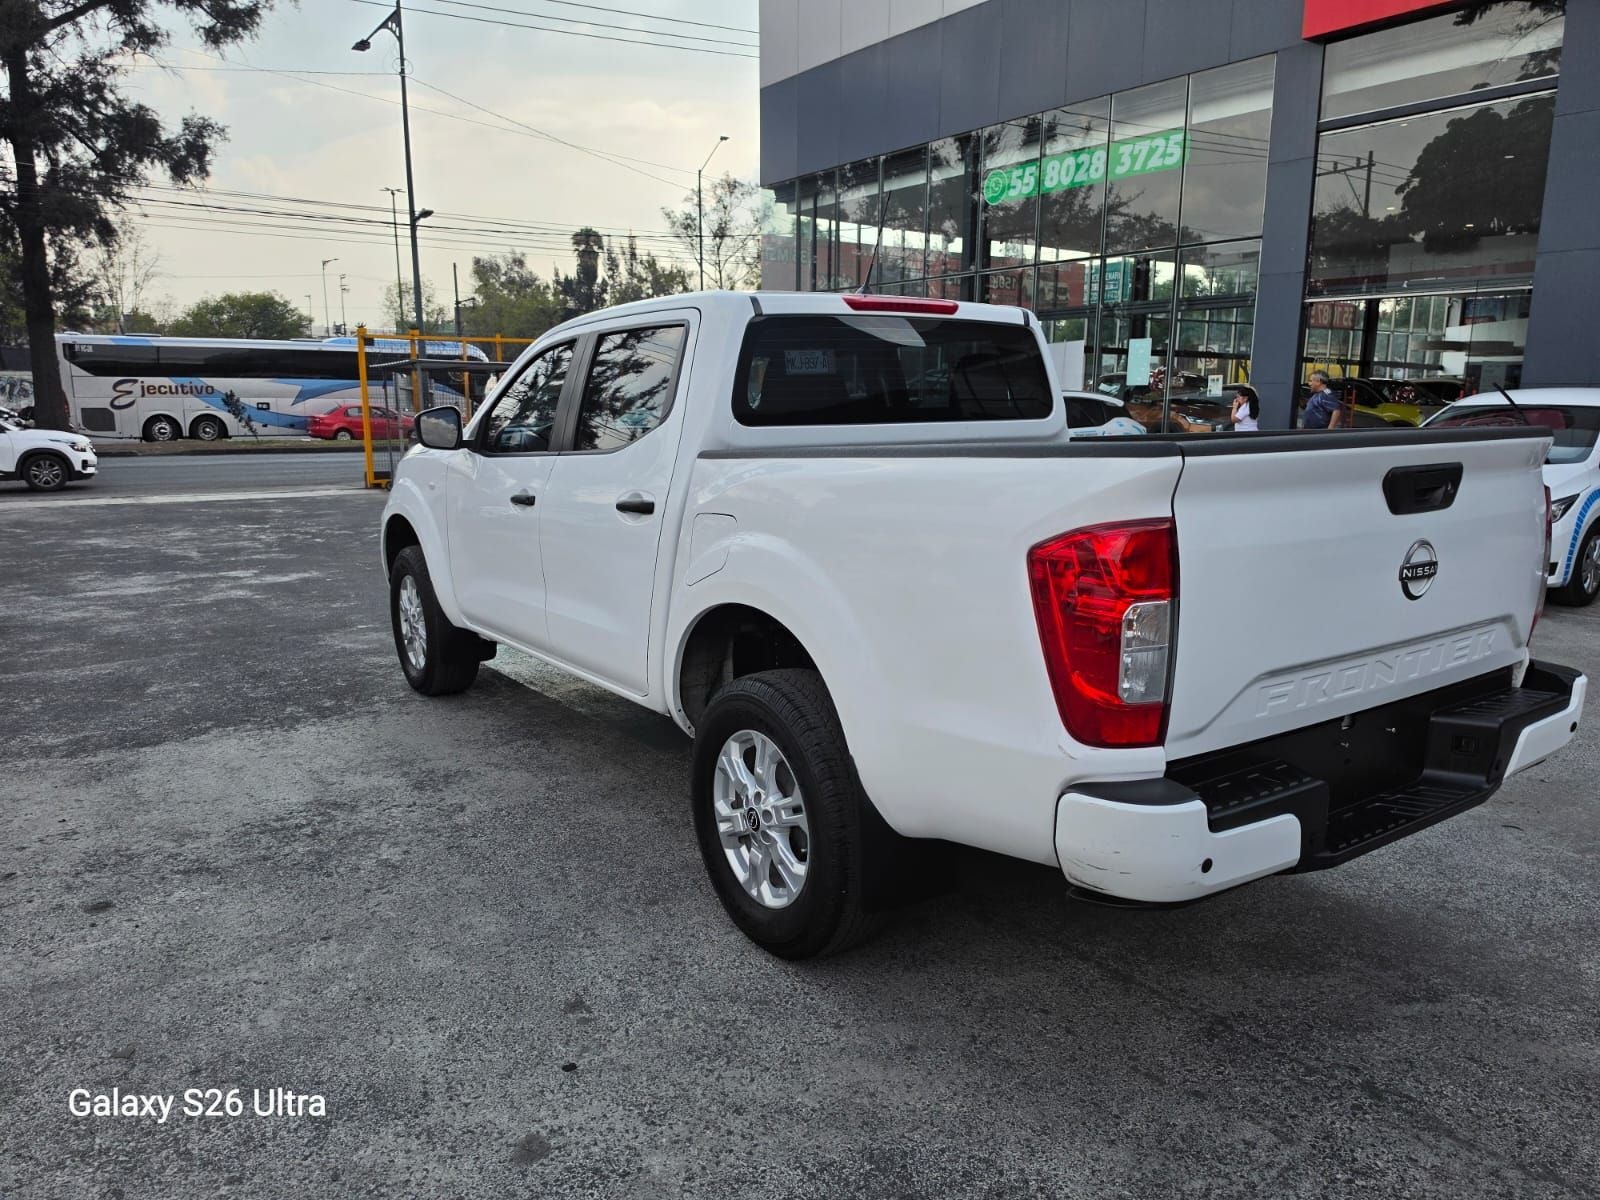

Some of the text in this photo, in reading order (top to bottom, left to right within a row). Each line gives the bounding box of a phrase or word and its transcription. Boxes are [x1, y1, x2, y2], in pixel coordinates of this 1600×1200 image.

[1007, 133, 1185, 197] 55 8028 3725
[110, 378, 215, 410] Ejecutivo
[1402, 565, 1436, 578] NISSA
[1256, 629, 1496, 717] FRONTIER
